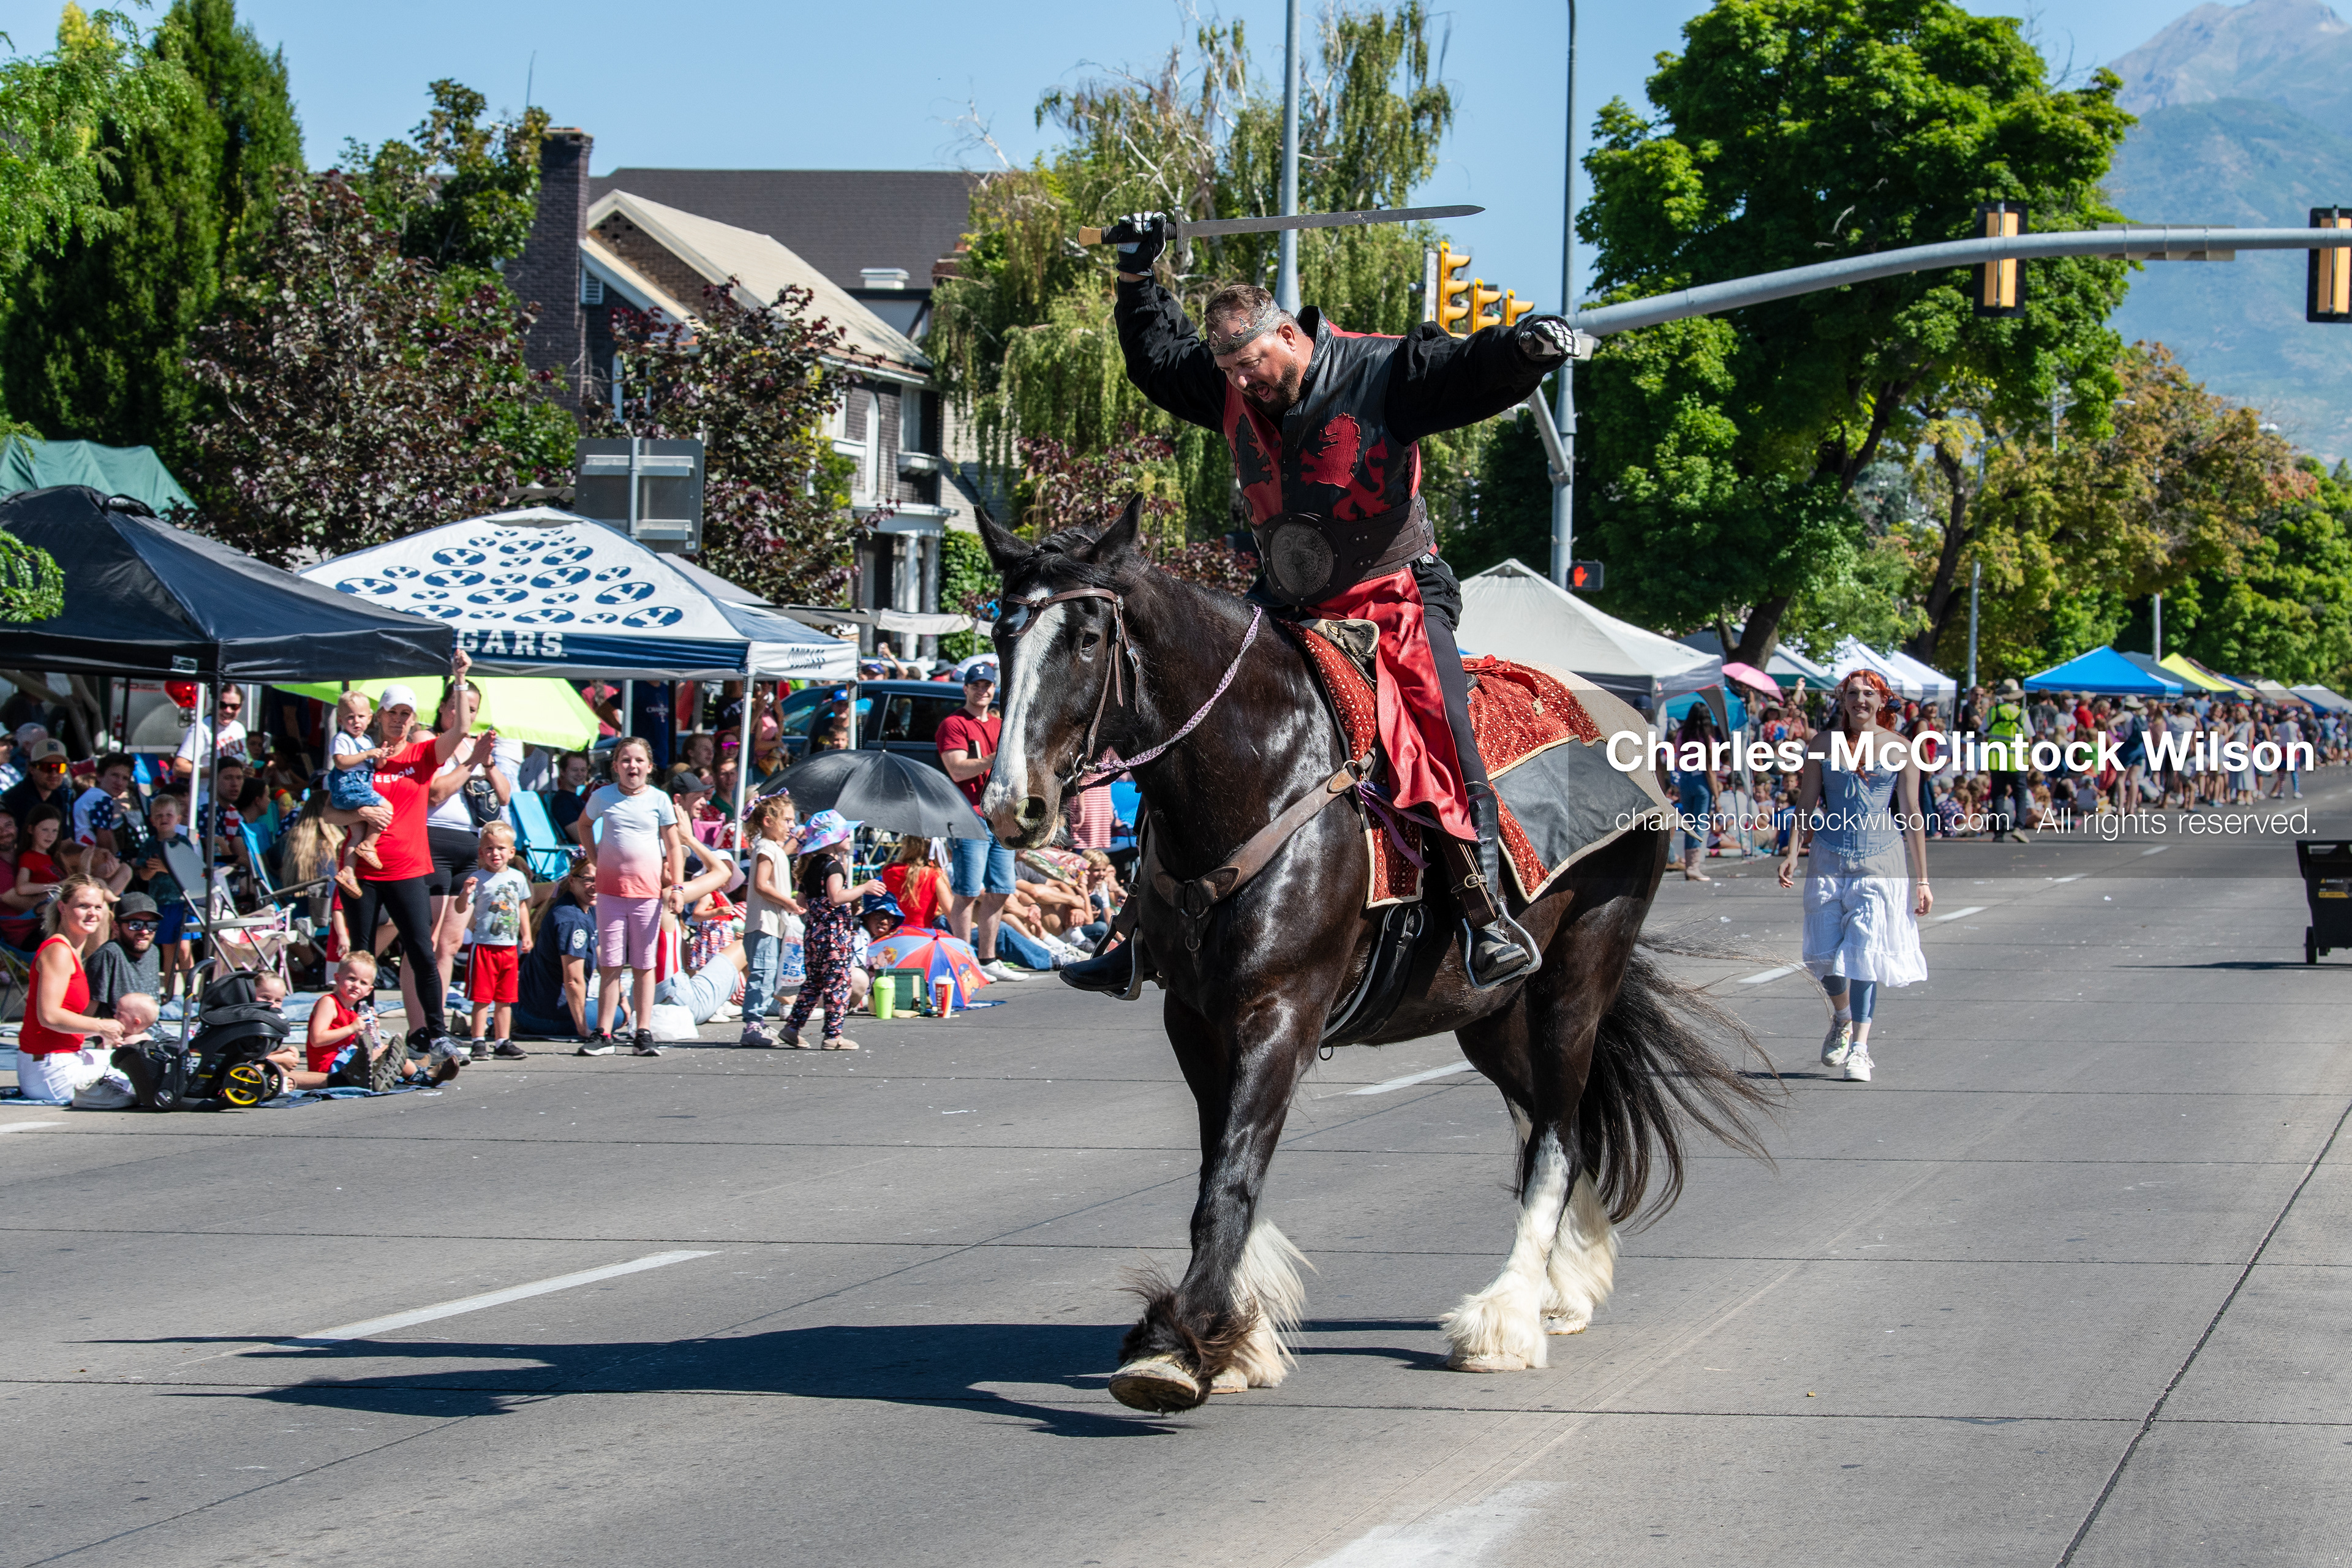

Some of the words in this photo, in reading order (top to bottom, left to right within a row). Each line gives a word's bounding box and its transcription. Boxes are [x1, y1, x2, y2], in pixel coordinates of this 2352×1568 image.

[505, 540, 539, 554] Y
[439, 549, 480, 566] Y
[548, 546, 587, 565] Y
[432, 570, 478, 587] Y
[538, 567, 584, 588] Y
[344, 578, 390, 594] Y
[602, 582, 647, 604] Y
[475, 589, 521, 605] Y
[409, 605, 455, 619] Y
[521, 609, 567, 624] Y
[629, 607, 675, 628] Y
[456, 628, 563, 657] GARS
[976, 666, 985, 674] Y
[375, 767, 415, 783] EEDOM
